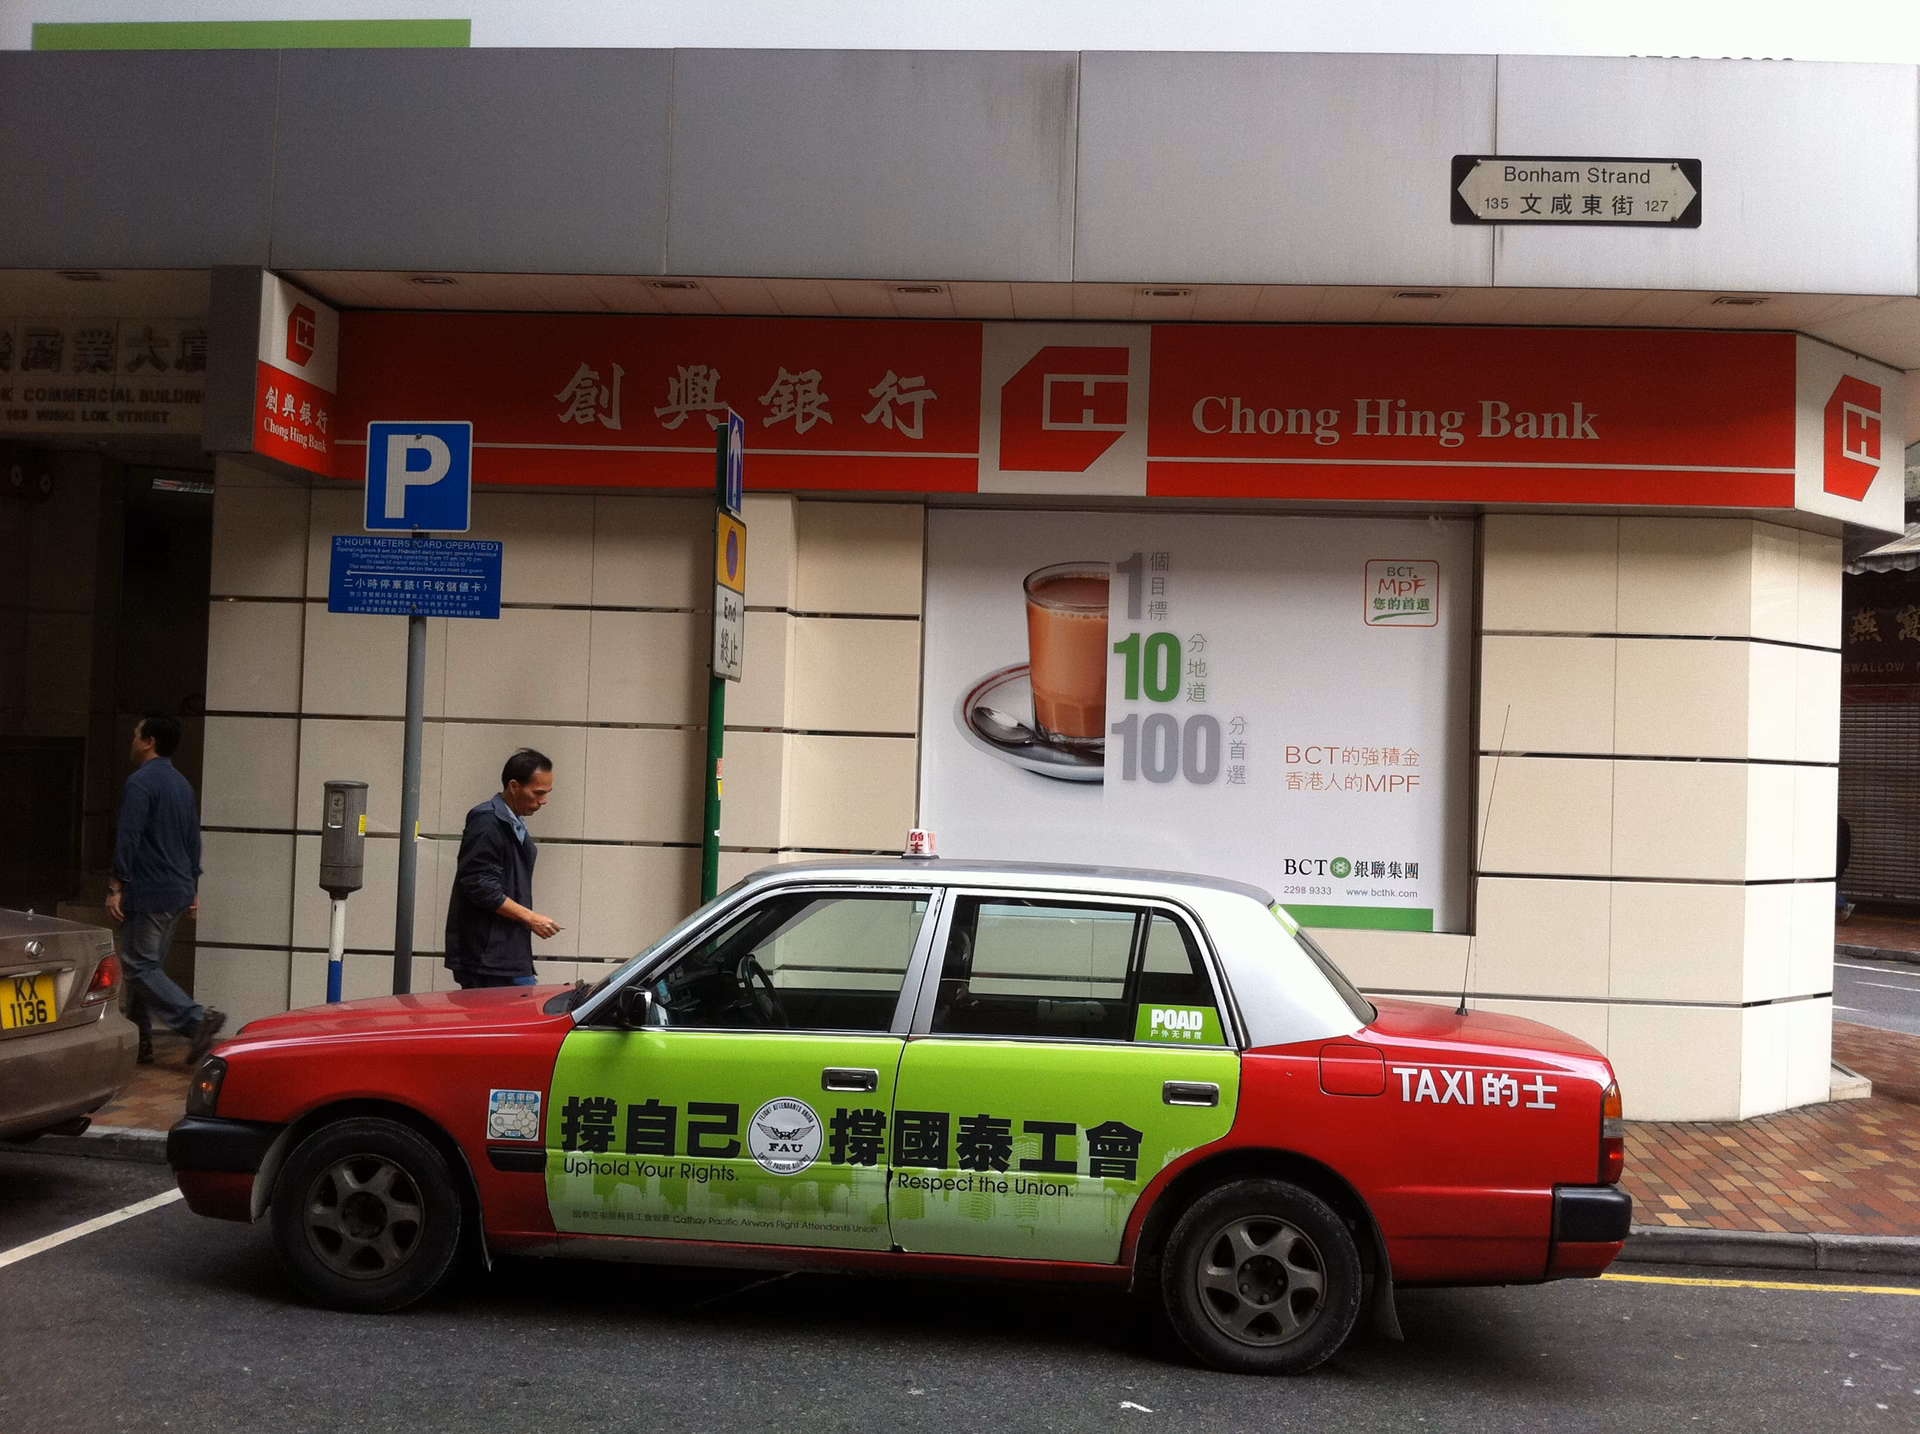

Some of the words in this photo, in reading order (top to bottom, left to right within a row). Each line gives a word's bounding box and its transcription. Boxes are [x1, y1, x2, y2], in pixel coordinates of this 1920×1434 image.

[1504, 165, 1580, 183] Bonham
[1587, 167, 1651, 184] Strand
[1484, 197, 1509, 210] 135
[1520, 192, 1633, 216] 文咸東街
[1645, 200, 1669, 213] 127
[23, 387, 132, 404] COMMERCIAL
[138, 388, 205, 404] BUILDIN
[554, 362, 938, 440] 創興銀行
[81, 409, 109, 422] LOK
[115, 410, 169, 423] STREET
[265, 385, 329, 435] 創興銀行
[1191, 395, 1341, 446] Chong
[1352, 397, 1466, 448] Hing
[1477, 400, 1600, 441] Bank
[263, 416, 289, 442] Chong
[290, 426, 308, 450] Hing
[308, 433, 327, 453] Bank
[384, 434, 452, 519] P
[335, 537, 371, 546] 2-HOUR
[373, 539, 410, 548] METERS
[1386, 566, 1415, 578] BCT
[1116, 552, 1143, 620] 1
[1147, 551, 1170, 622] 個目標
[723, 596, 737, 623] End
[1373, 597, 1430, 611] 您的首選
[720, 627, 738, 669] 終止
[1113, 631, 1182, 703] 10
[1186, 633, 1208, 703] 分地道
[1843, 661, 1906, 674] SWALLOW
[1111, 712, 1221, 785] 100
[1226, 715, 1248, 785] 分首選
[1285, 745, 1420, 767] BCT的強積金
[1285, 772, 1421, 793] 香港人的MPF
[1284, 858, 1328, 876] BCT
[1353, 859, 1419, 880] 銀聯集團
[1283, 885, 1307, 895] 2298
[1309, 886, 1332, 896] 9333
[1345, 887, 1418, 899] www.bcthk.com
[14, 976, 39, 1002] KX
[10, 1000, 48, 1028] 1136
[1151, 1008, 1203, 1030] POAD
[1392, 1066, 1475, 1106] TAXI
[1481, 1071, 1558, 1110] 的士
[757, 1106, 773, 1122] FLIGHT
[772, 1101, 803, 1113] ATTENDANTS
[801, 1109, 815, 1124] UNION
[561, 1095, 742, 1160] 撐自己
[768, 1142, 804, 1154] FAU
[829, 1107, 1144, 1181] 撐國泰工會
[563, 1157, 630, 1178] Uphold
[635, 1160, 676, 1179] Your
[680, 1162, 740, 1184] Rights.
[773, 1162, 792, 1171] PACIFIC
[898, 1172, 974, 1193] Respect
[979, 1176, 1009, 1195] the
[1015, 1178, 1075, 1198] Union.
[672, 1215, 707, 1226] Cathay
[708, 1215, 739, 1227] Pacific
[740, 1218, 775, 1230] Airways
[776, 1218, 800, 1232] Flight
[801, 1220, 851, 1233] Attendants
[852, 1223, 878, 1234] Union
